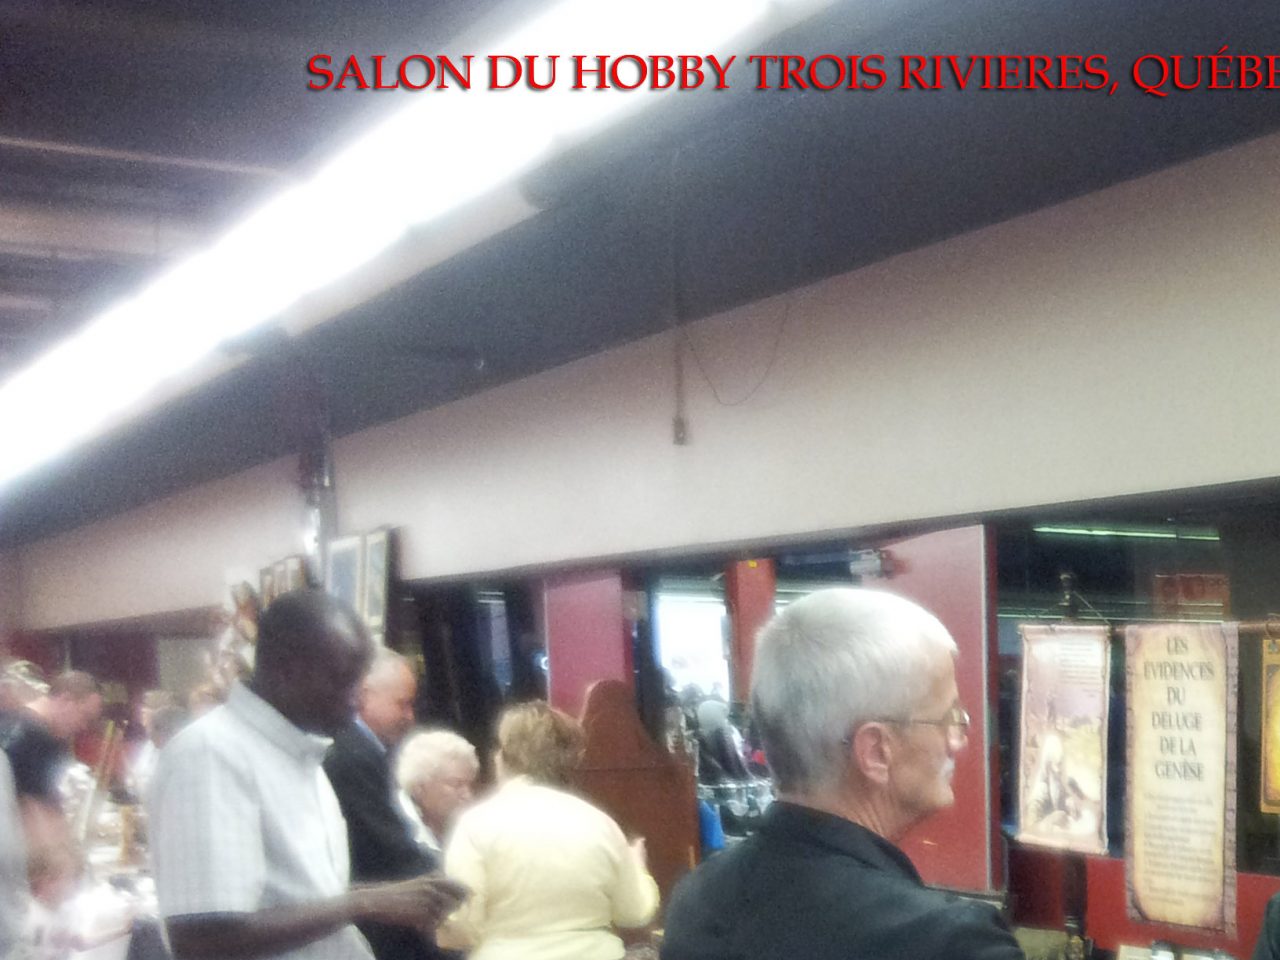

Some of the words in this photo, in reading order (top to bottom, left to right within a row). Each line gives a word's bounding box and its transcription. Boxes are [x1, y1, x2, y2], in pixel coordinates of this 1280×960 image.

[1167, 636, 1188, 655] LES
[1167, 686, 1186, 706] DU
[1159, 735, 1177, 755] DE
[1180, 736, 1197, 757] LA
